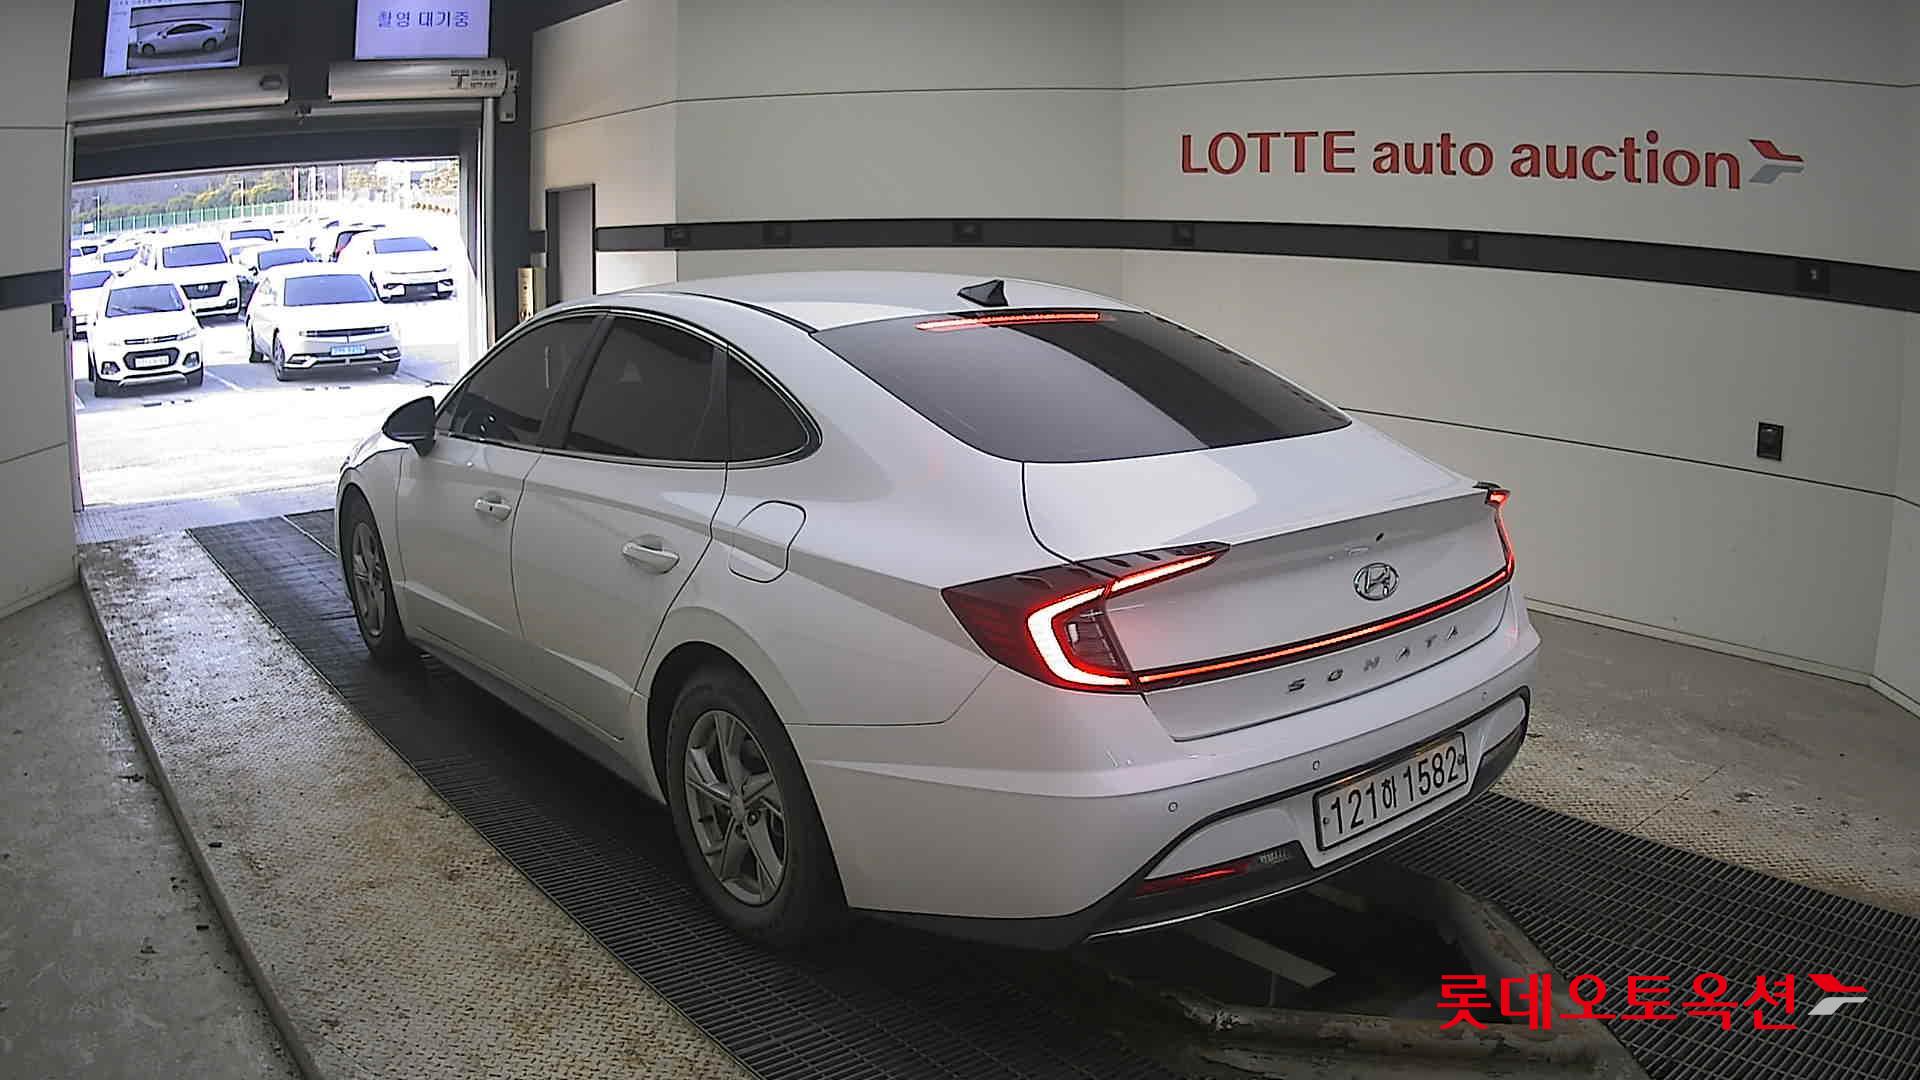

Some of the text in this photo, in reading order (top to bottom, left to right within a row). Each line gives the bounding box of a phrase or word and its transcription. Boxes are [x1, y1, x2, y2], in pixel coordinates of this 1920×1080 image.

[418, 10, 470, 28] 대기중
[1181, 129, 1741, 190] LOTTE auto auction
[1287, 624, 1458, 692] SONATA
